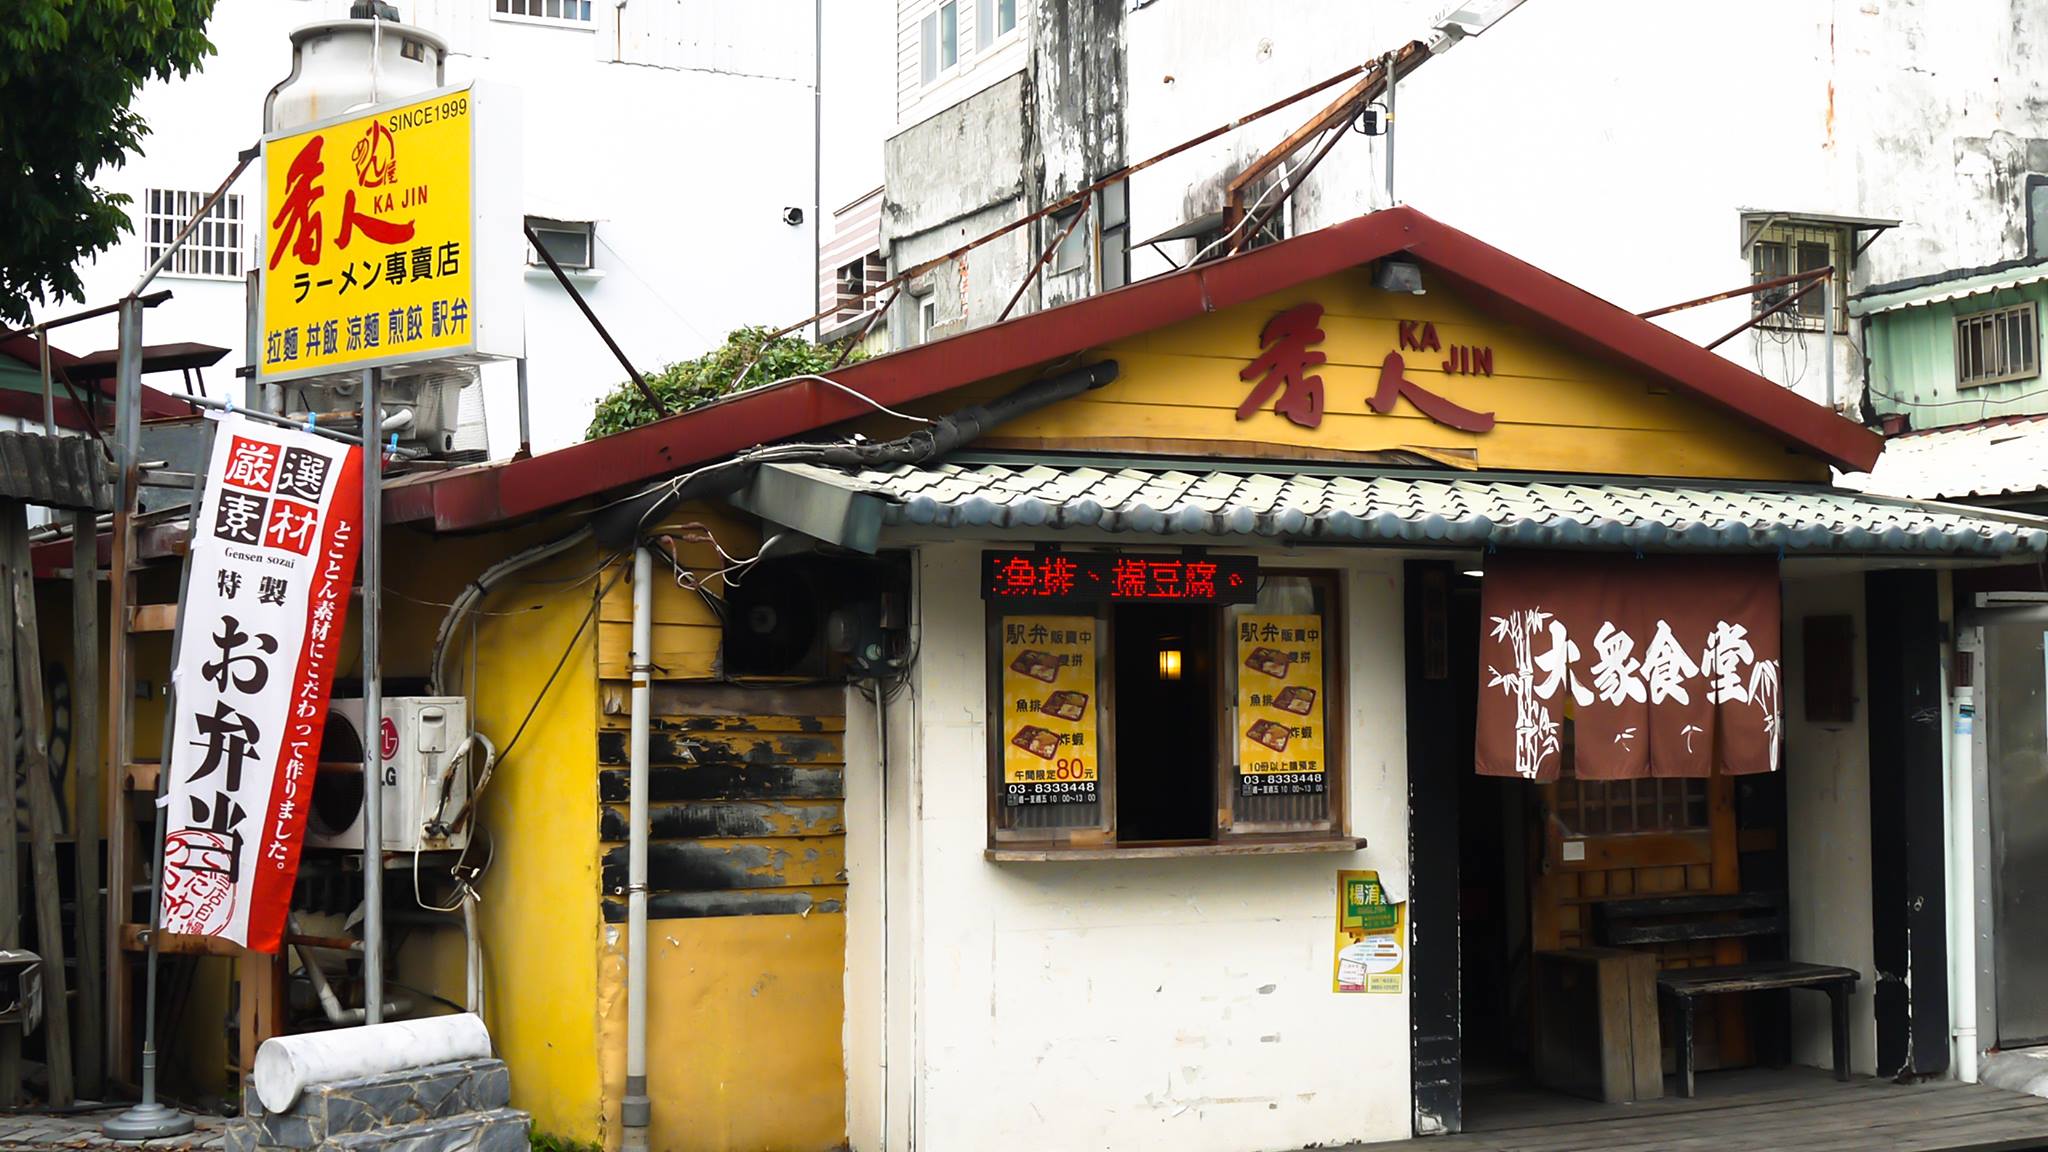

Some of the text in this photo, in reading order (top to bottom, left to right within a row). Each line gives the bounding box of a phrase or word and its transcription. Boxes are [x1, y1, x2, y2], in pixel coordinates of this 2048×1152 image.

[389, 98, 467, 132] SINCE1999
[269, 135, 416, 270] 香人
[374, 185, 428, 214] KA JIN
[306, 319, 339, 357] 丼飯
[388, 304, 423, 344] 煎餃
[432, 297, 468, 337] 駅弁
[1398, 320, 1493, 377] KA JIN
[1235, 303, 1495, 433] 香人
[225, 442, 326, 501] 厳選
[216, 495, 318, 551] 素材
[225, 547, 296, 569] Gensen sozai
[217, 568, 289, 607] 特製
[1016, 698, 1041, 713] 魚排
[180, 615, 279, 883] お弁当
[1059, 733, 1084, 746] 炸蝦
[381, 767, 397, 786] G
